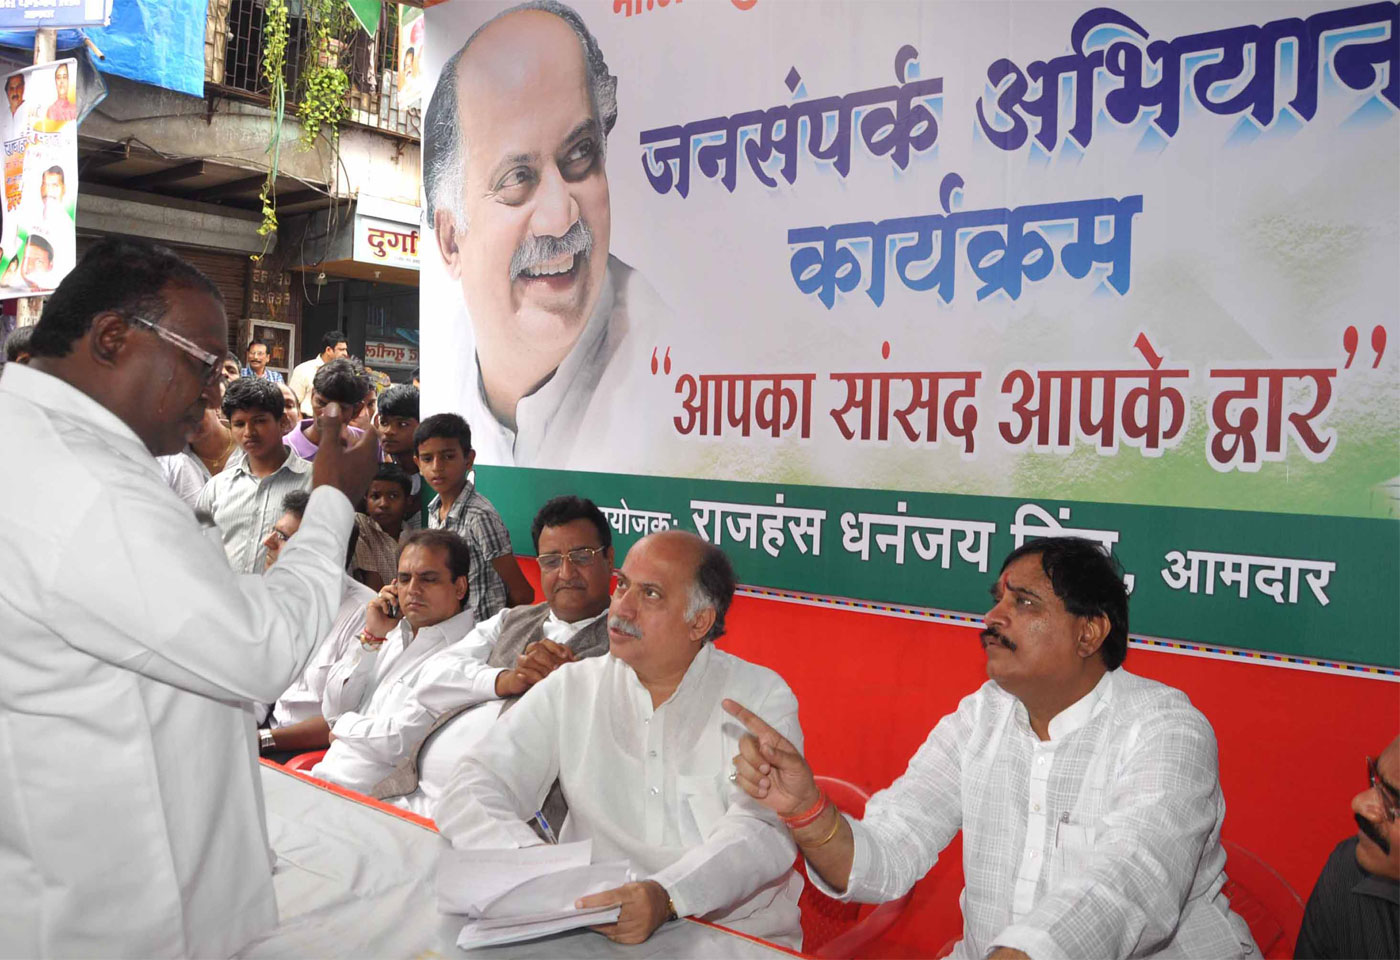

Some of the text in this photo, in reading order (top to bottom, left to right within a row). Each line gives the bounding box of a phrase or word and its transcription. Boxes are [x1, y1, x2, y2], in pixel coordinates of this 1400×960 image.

[640, 7, 1400, 199] जनसंपर्क अभियान
[787, 172, 1143, 310] कार्यक्रम
[829, 341, 982, 453] सांसद
[999, 332, 1189, 450] आपके
[690, 493, 826, 558] राजहंस
[840, 502, 996, 574] धनंजय
[1160, 549, 1337, 607] आमदार
